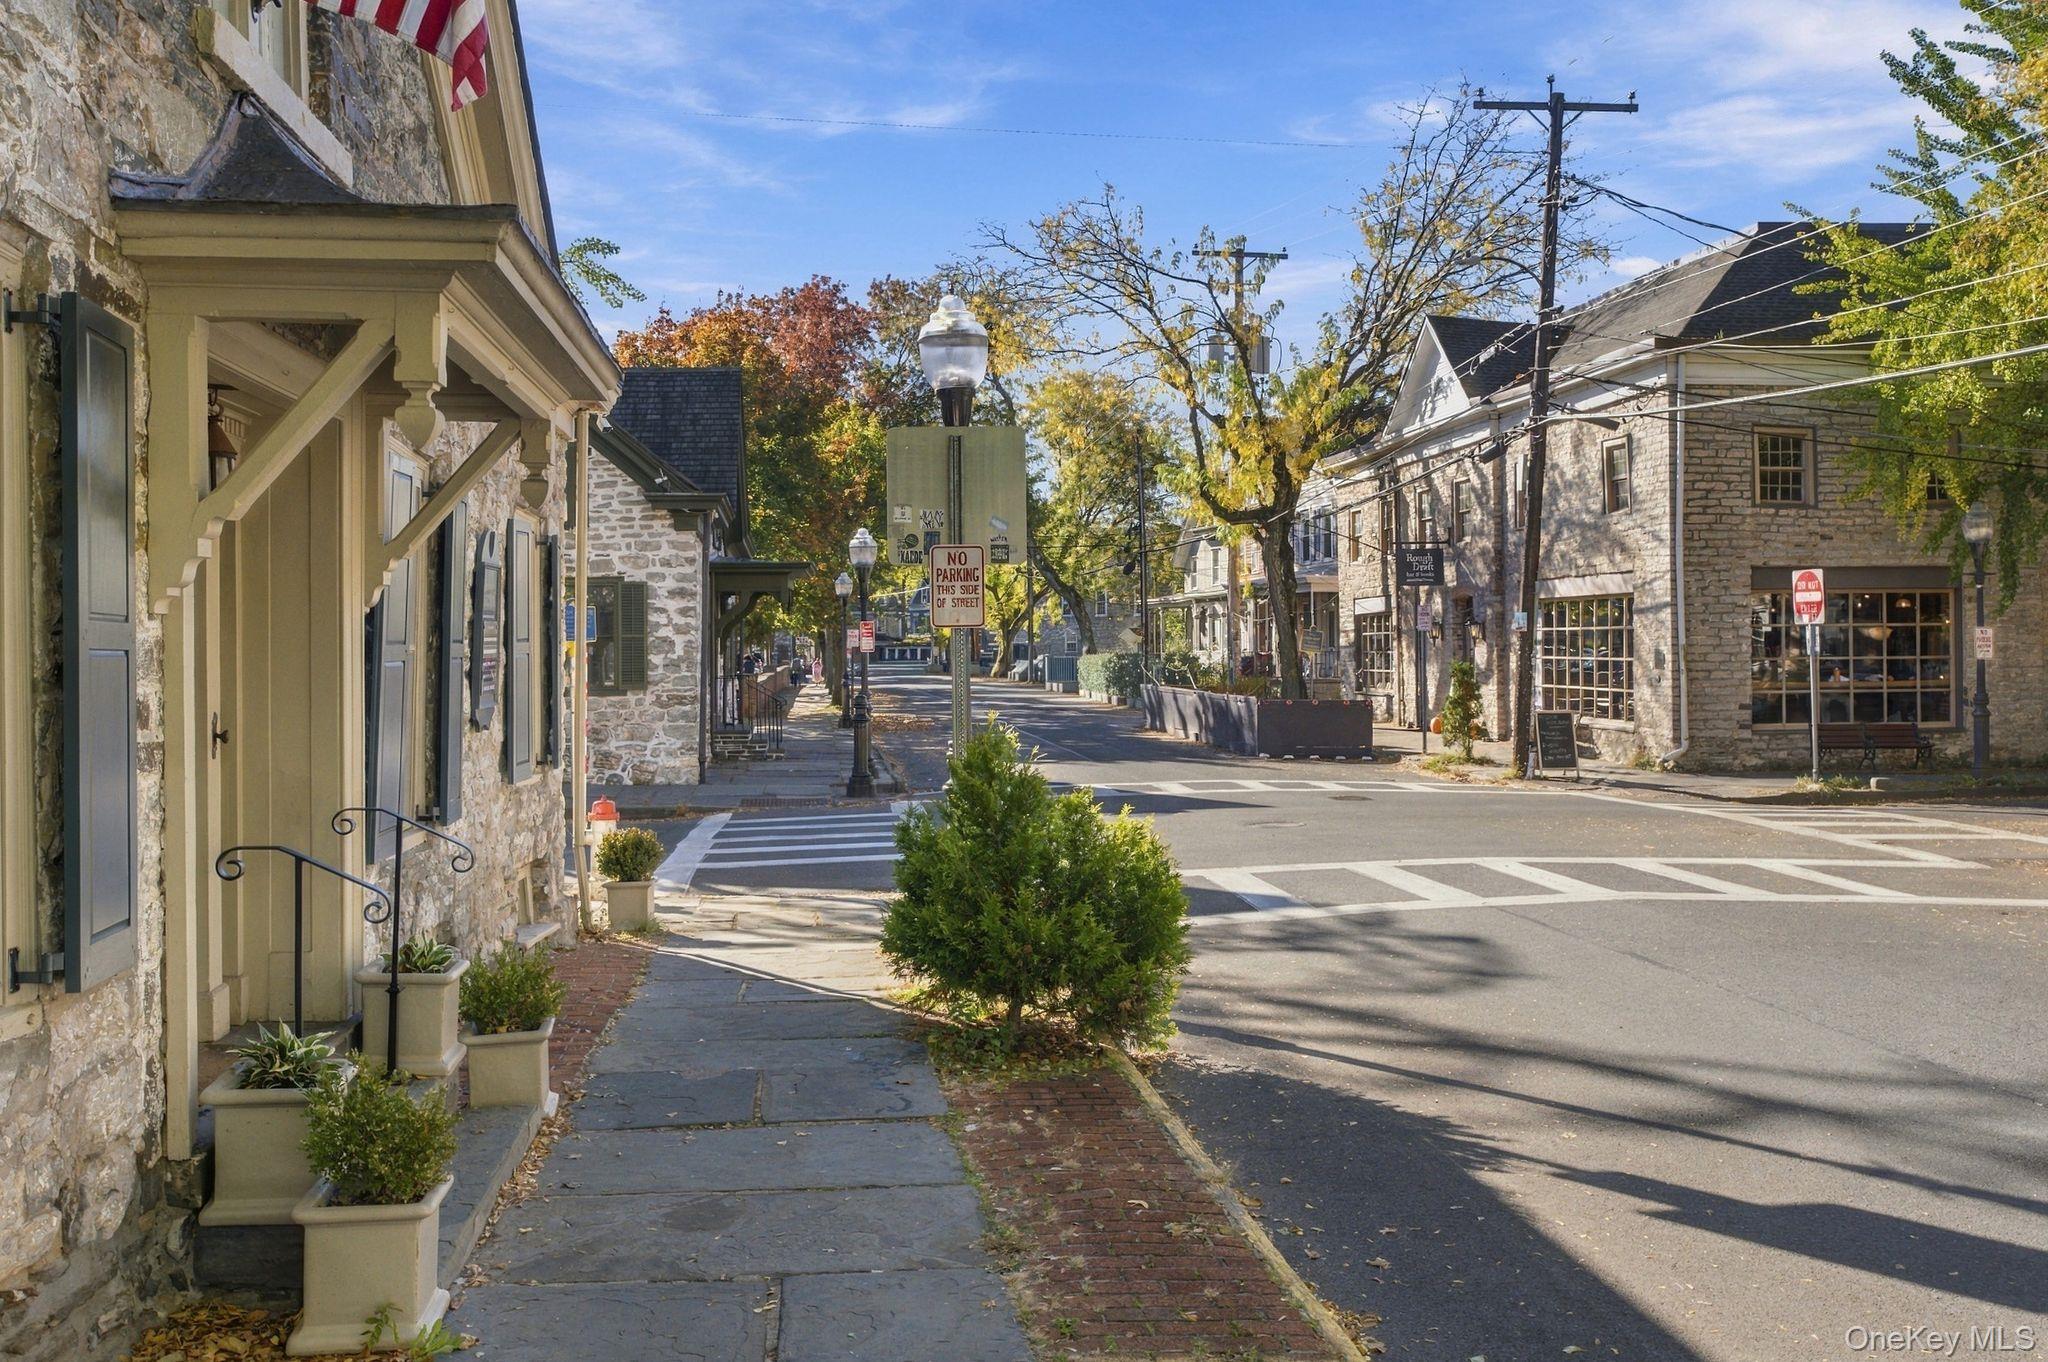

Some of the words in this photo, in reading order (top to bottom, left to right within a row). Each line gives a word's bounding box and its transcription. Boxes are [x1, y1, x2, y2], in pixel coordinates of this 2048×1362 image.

[947, 551, 968, 566] NO
[1406, 553, 1433, 564] Rough
[1413, 562, 1434, 571] Draft
[936, 567, 980, 582] PARKING
[936, 585, 956, 595] THIS
[960, 585, 980, 595] SIDE
[1797, 581, 1806, 590] DO
[1808, 581, 1819, 590] NOT
[937, 597, 947, 608] OF
[951, 597, 980, 608] STREET
